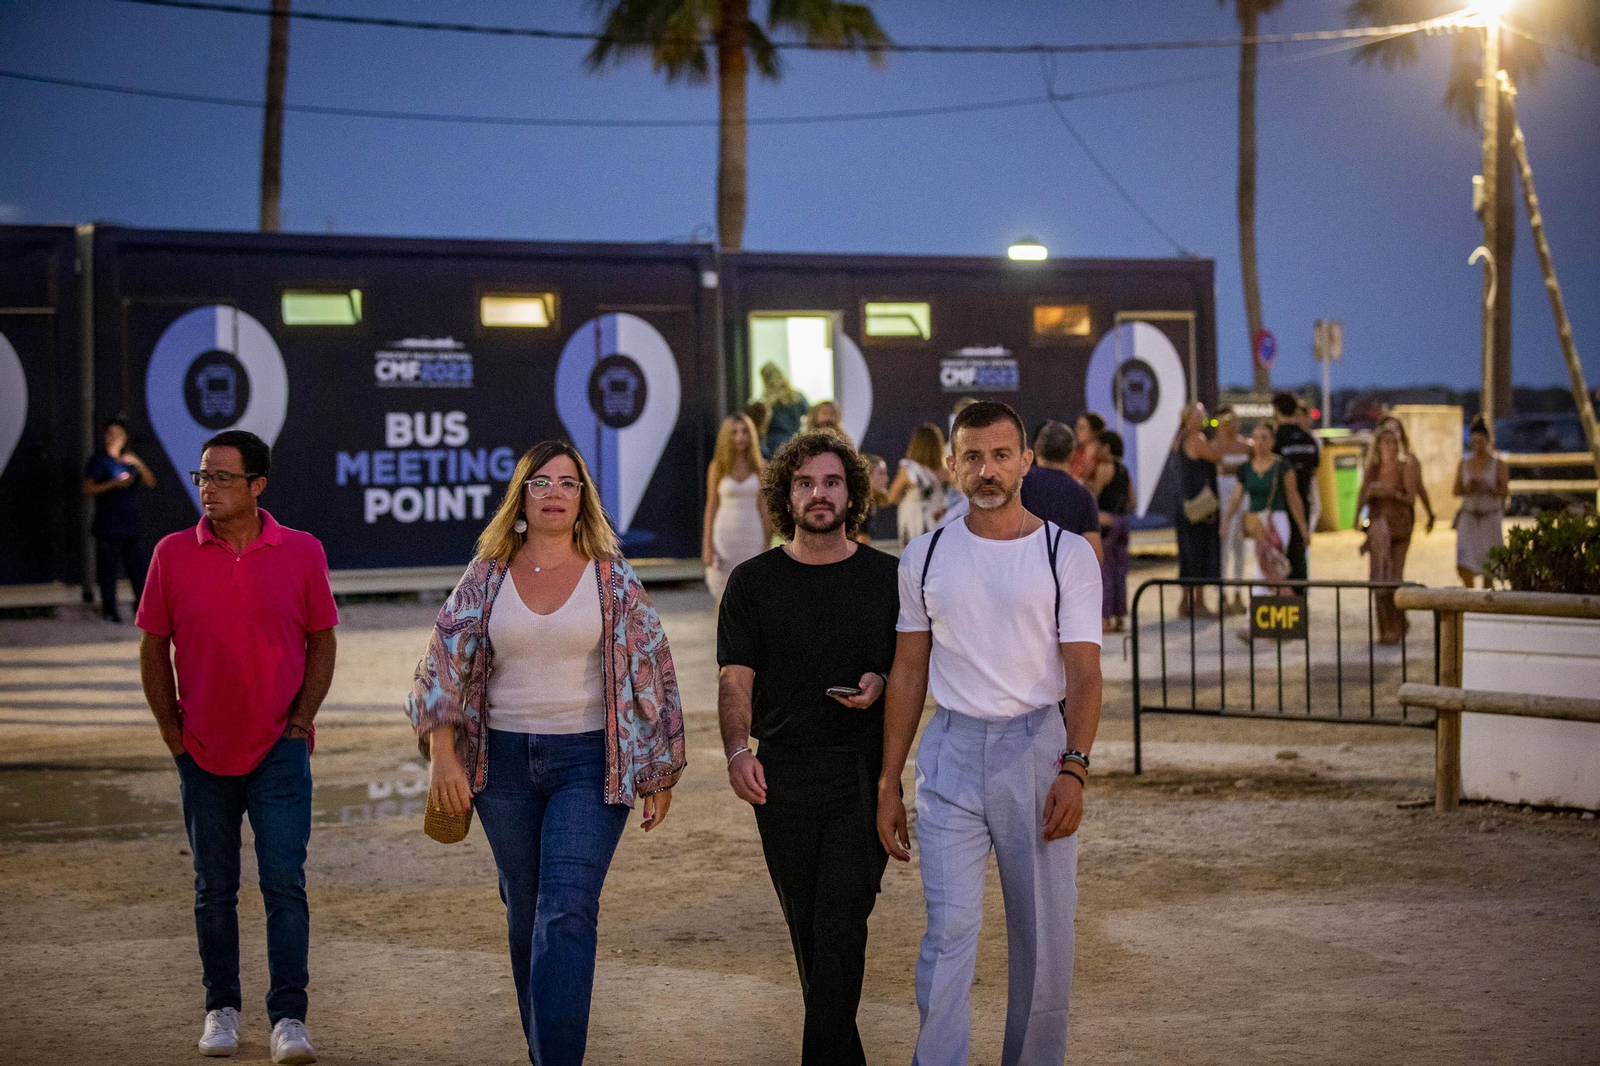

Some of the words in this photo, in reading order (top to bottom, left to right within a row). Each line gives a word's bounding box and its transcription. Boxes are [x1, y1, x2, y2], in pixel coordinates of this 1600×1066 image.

[385, 411, 470, 447] BUS
[336, 446, 515, 485] MEETING
[364, 484, 492, 524] POINT
[1256, 605, 1300, 629] CMF
